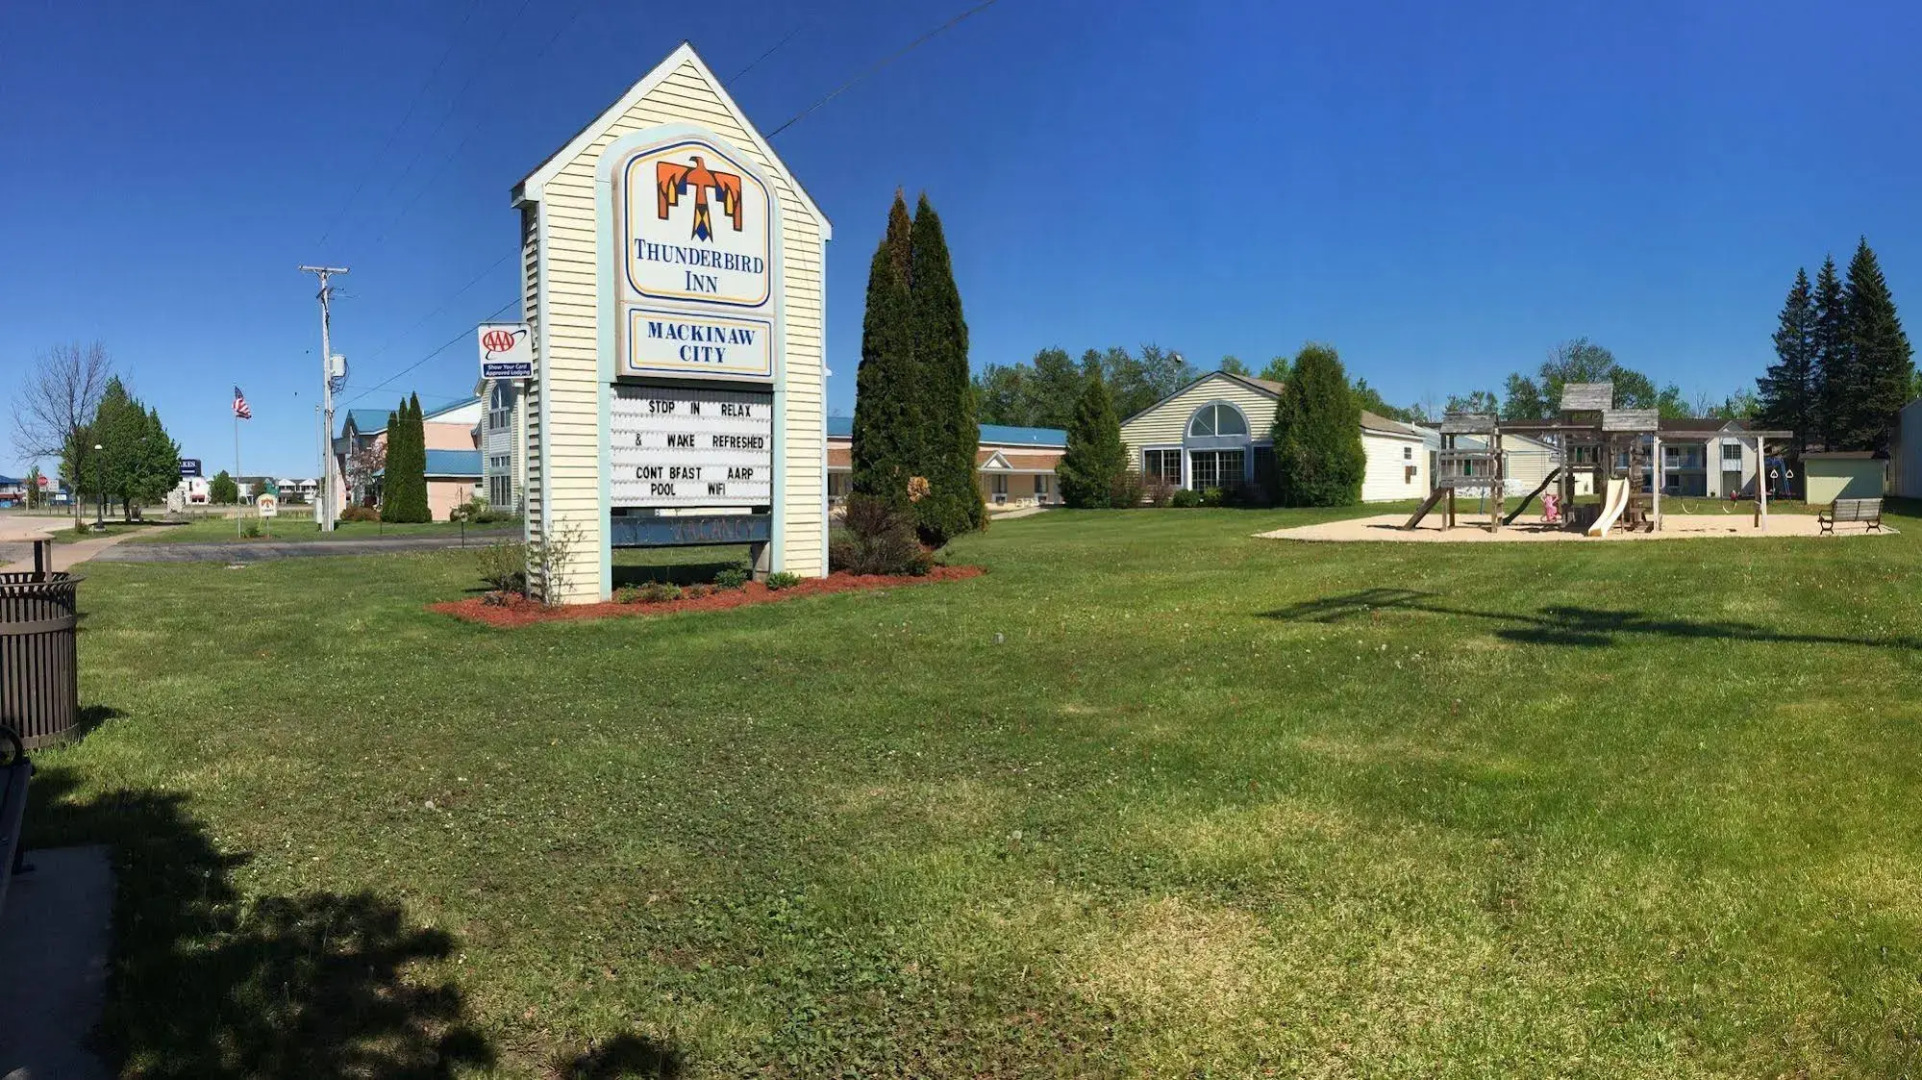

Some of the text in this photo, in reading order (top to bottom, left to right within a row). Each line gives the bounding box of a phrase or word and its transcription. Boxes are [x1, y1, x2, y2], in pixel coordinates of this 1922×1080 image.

[634, 238, 764, 274] THUNDERBIRD
[685, 270, 718, 293] INN
[648, 321, 756, 345] MACKINAW
[679, 345, 727, 363] CITY
[649, 400, 751, 417] STOP IN RELAX
[635, 434, 764, 449] & WAKE REFRESHED
[636, 467, 753, 480] CONT BFAST AARP
[651, 483, 726, 496] POOL WIFI
